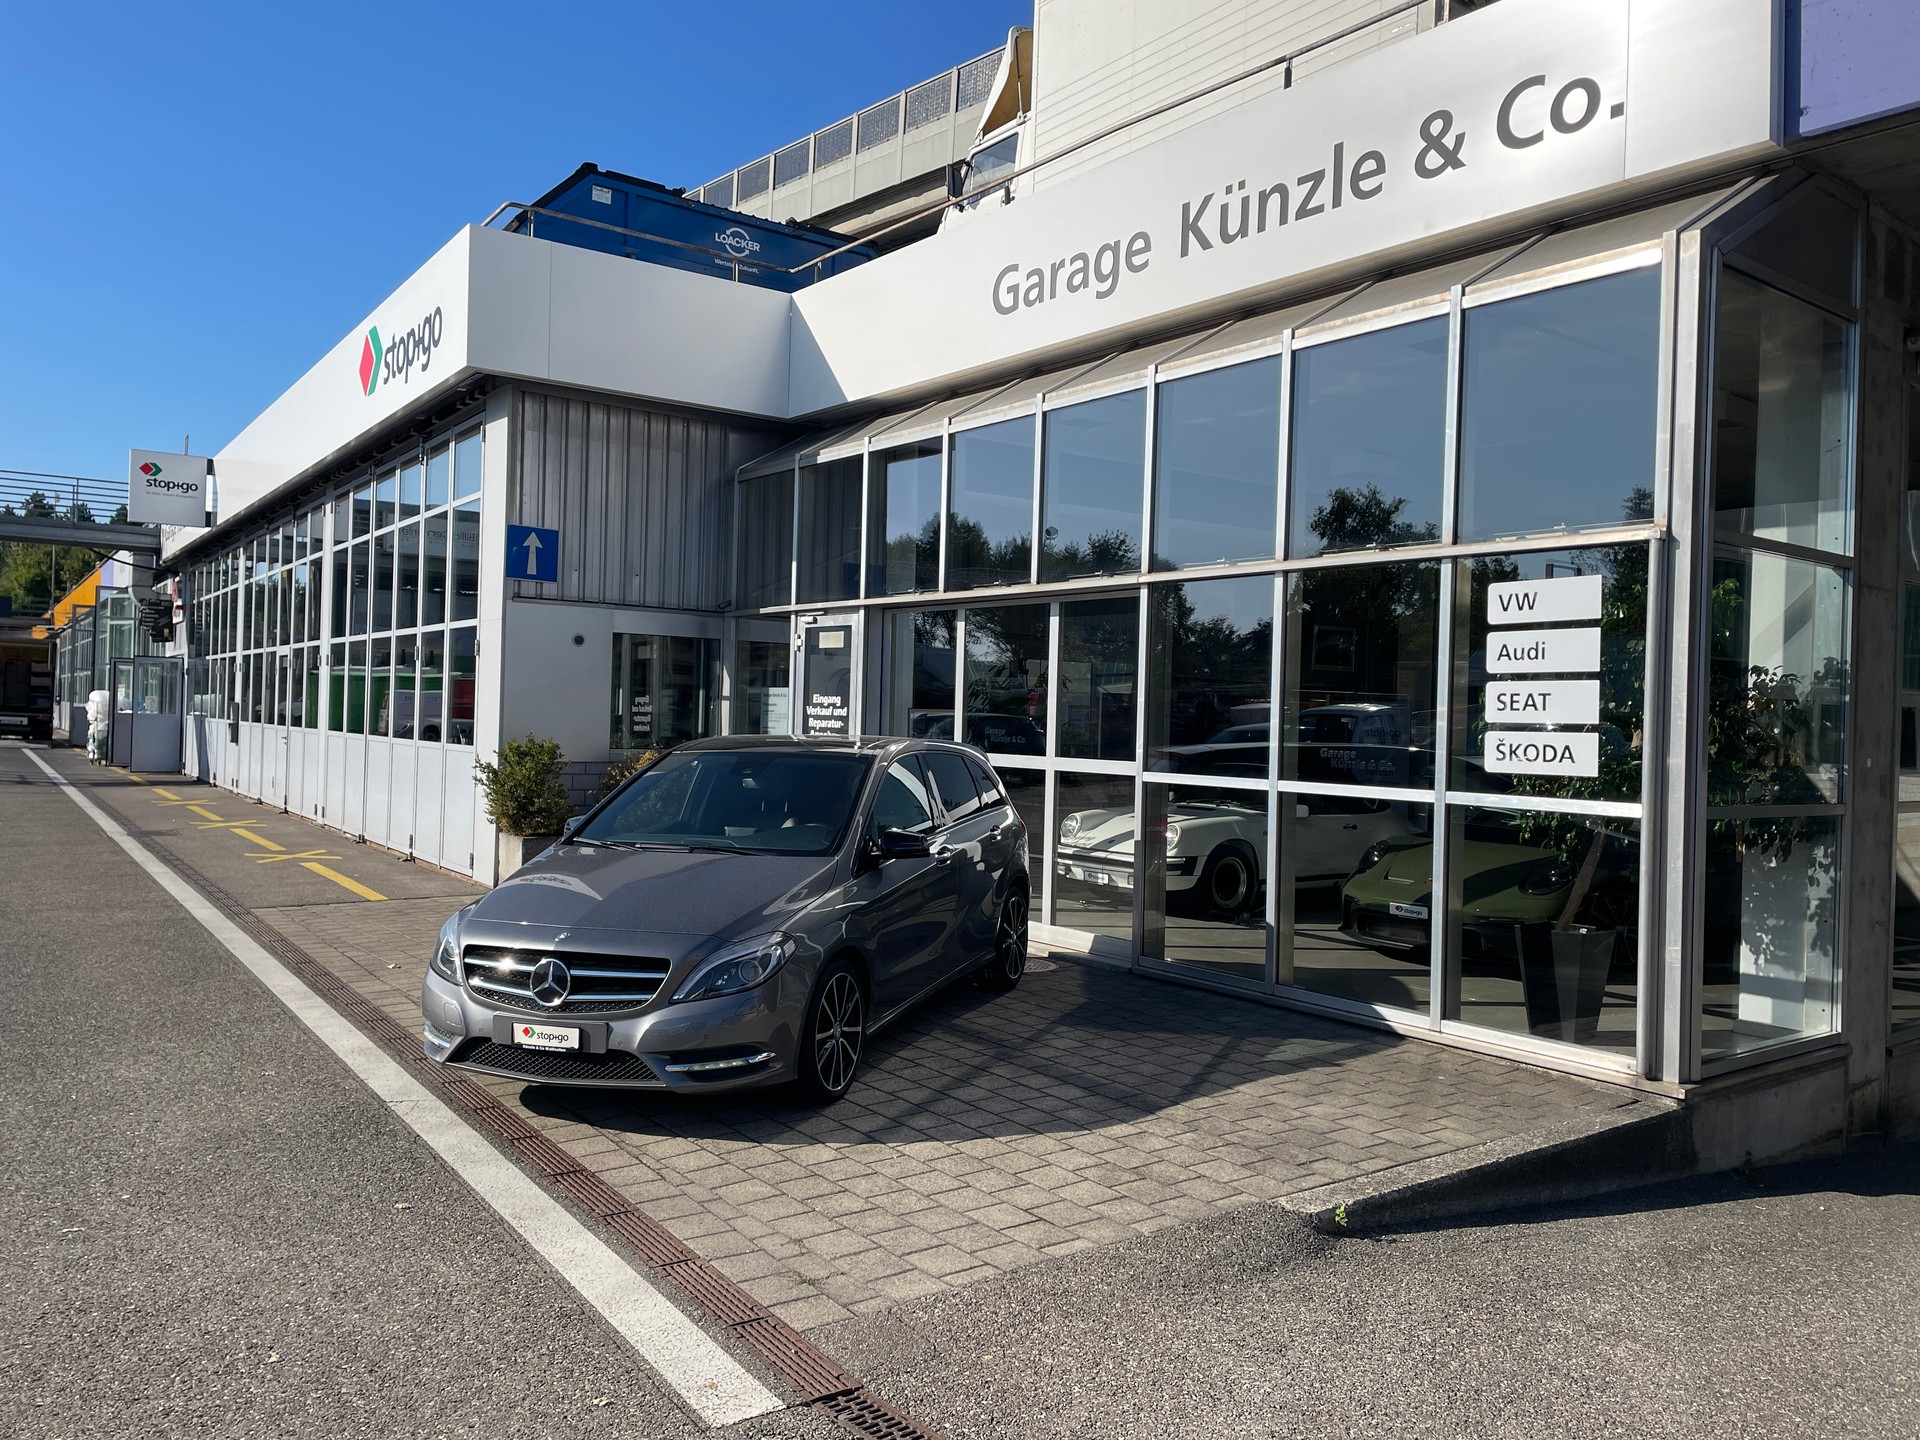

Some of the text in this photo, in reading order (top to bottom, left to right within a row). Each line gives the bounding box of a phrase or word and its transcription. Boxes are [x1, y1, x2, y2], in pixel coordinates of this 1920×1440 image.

[993, 74, 1625, 316] Garage Künzle & Co.
[715, 232, 760, 251] LOACKER
[383, 305, 443, 386] stop+go
[145, 477, 199, 494] stop+go
[1498, 591, 1538, 612] VW
[1496, 641, 1546, 661] Audi
[812, 693, 842, 706] Eingang
[1496, 692, 1551, 711] SEAT
[806, 705, 848, 716] Verkauf und
[808, 717, 844, 730] Reparatur-
[985, 727, 1005, 736] Garage
[1320, 748, 1356, 760] Garage
[1495, 738, 1576, 764] ŠKODA
[537, 1032, 569, 1043] stop+go
